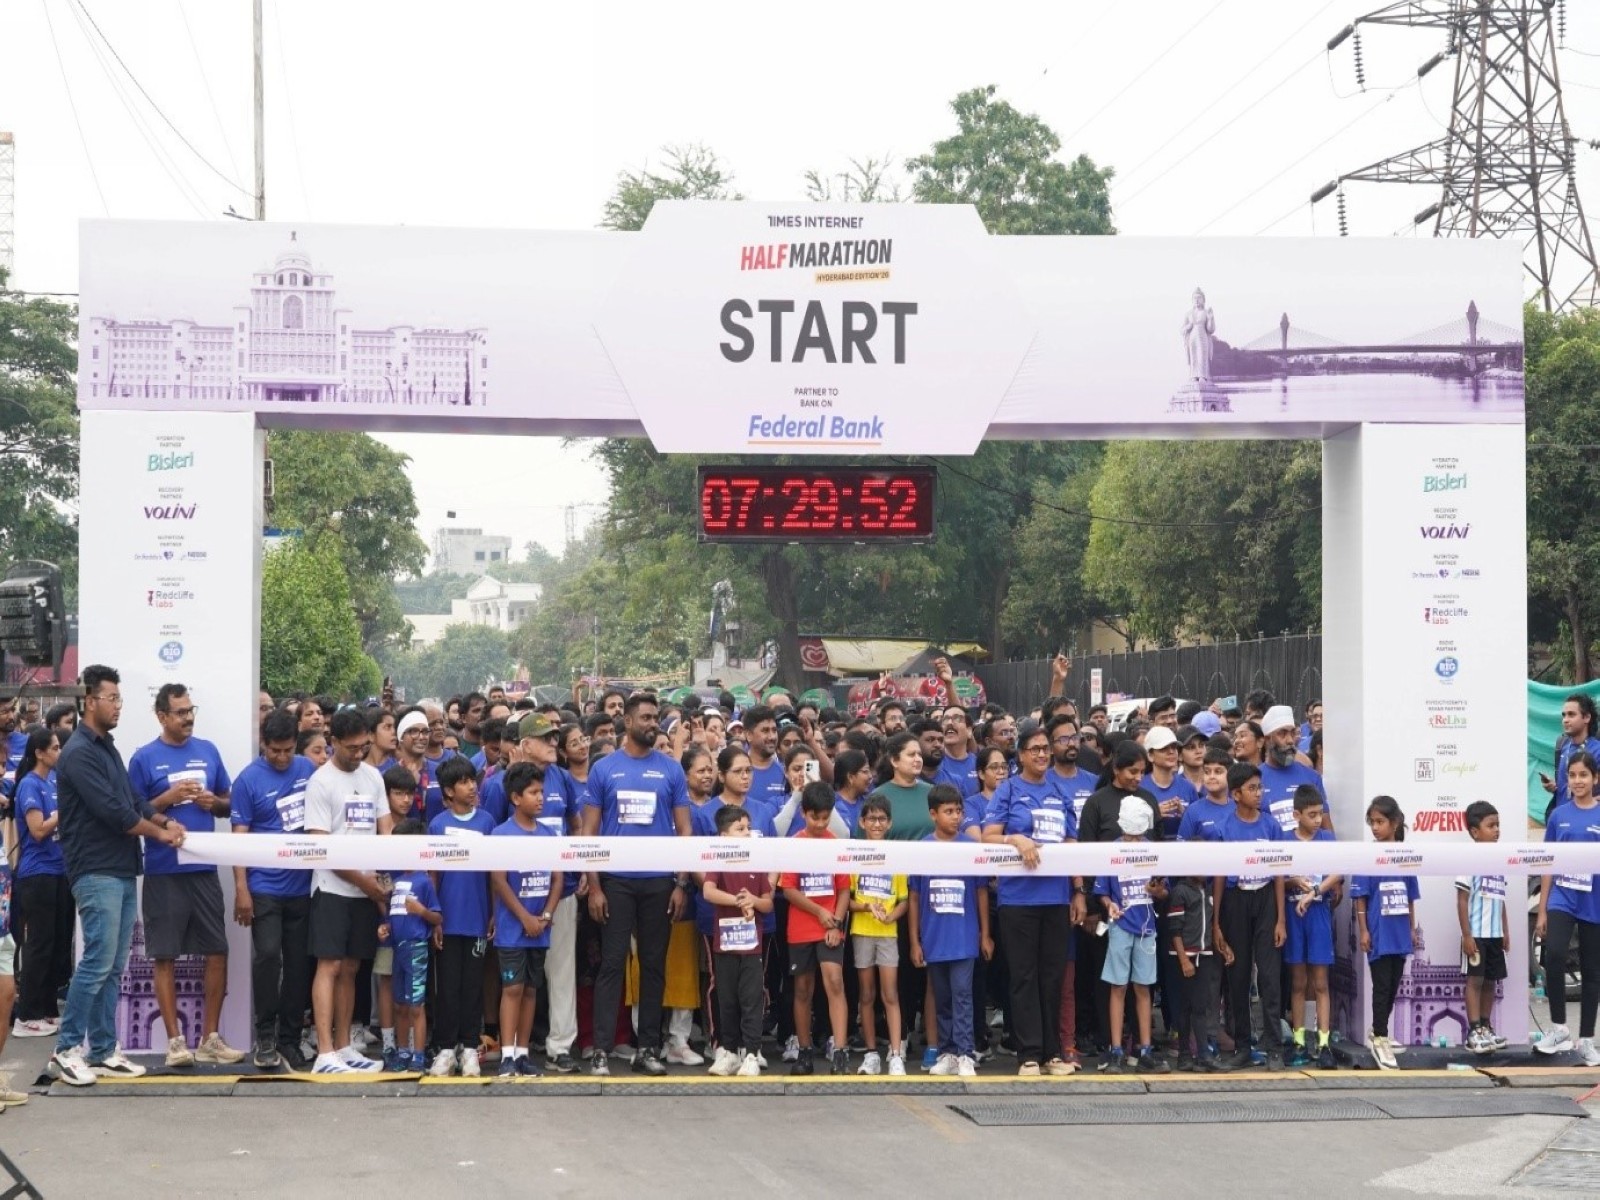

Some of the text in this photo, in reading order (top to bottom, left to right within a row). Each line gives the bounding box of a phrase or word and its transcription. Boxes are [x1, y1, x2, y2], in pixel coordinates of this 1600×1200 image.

[768, 216, 864, 228] TIMES INTERNET
[816, 273, 854, 282] HYDERABAD
[720, 298, 918, 364] START
[794, 387, 839, 396] PARTNER TO
[800, 398, 832, 408] BANK ON
[748, 414, 884, 439] Federal Bank
[148, 451, 194, 472] Bisleri
[1423, 472, 1468, 492] Bisleri
[702, 478, 918, 528] 07:29:52
[156, 590, 194, 600] Redcliffe
[1432, 607, 1468, 617] Redcliffe
